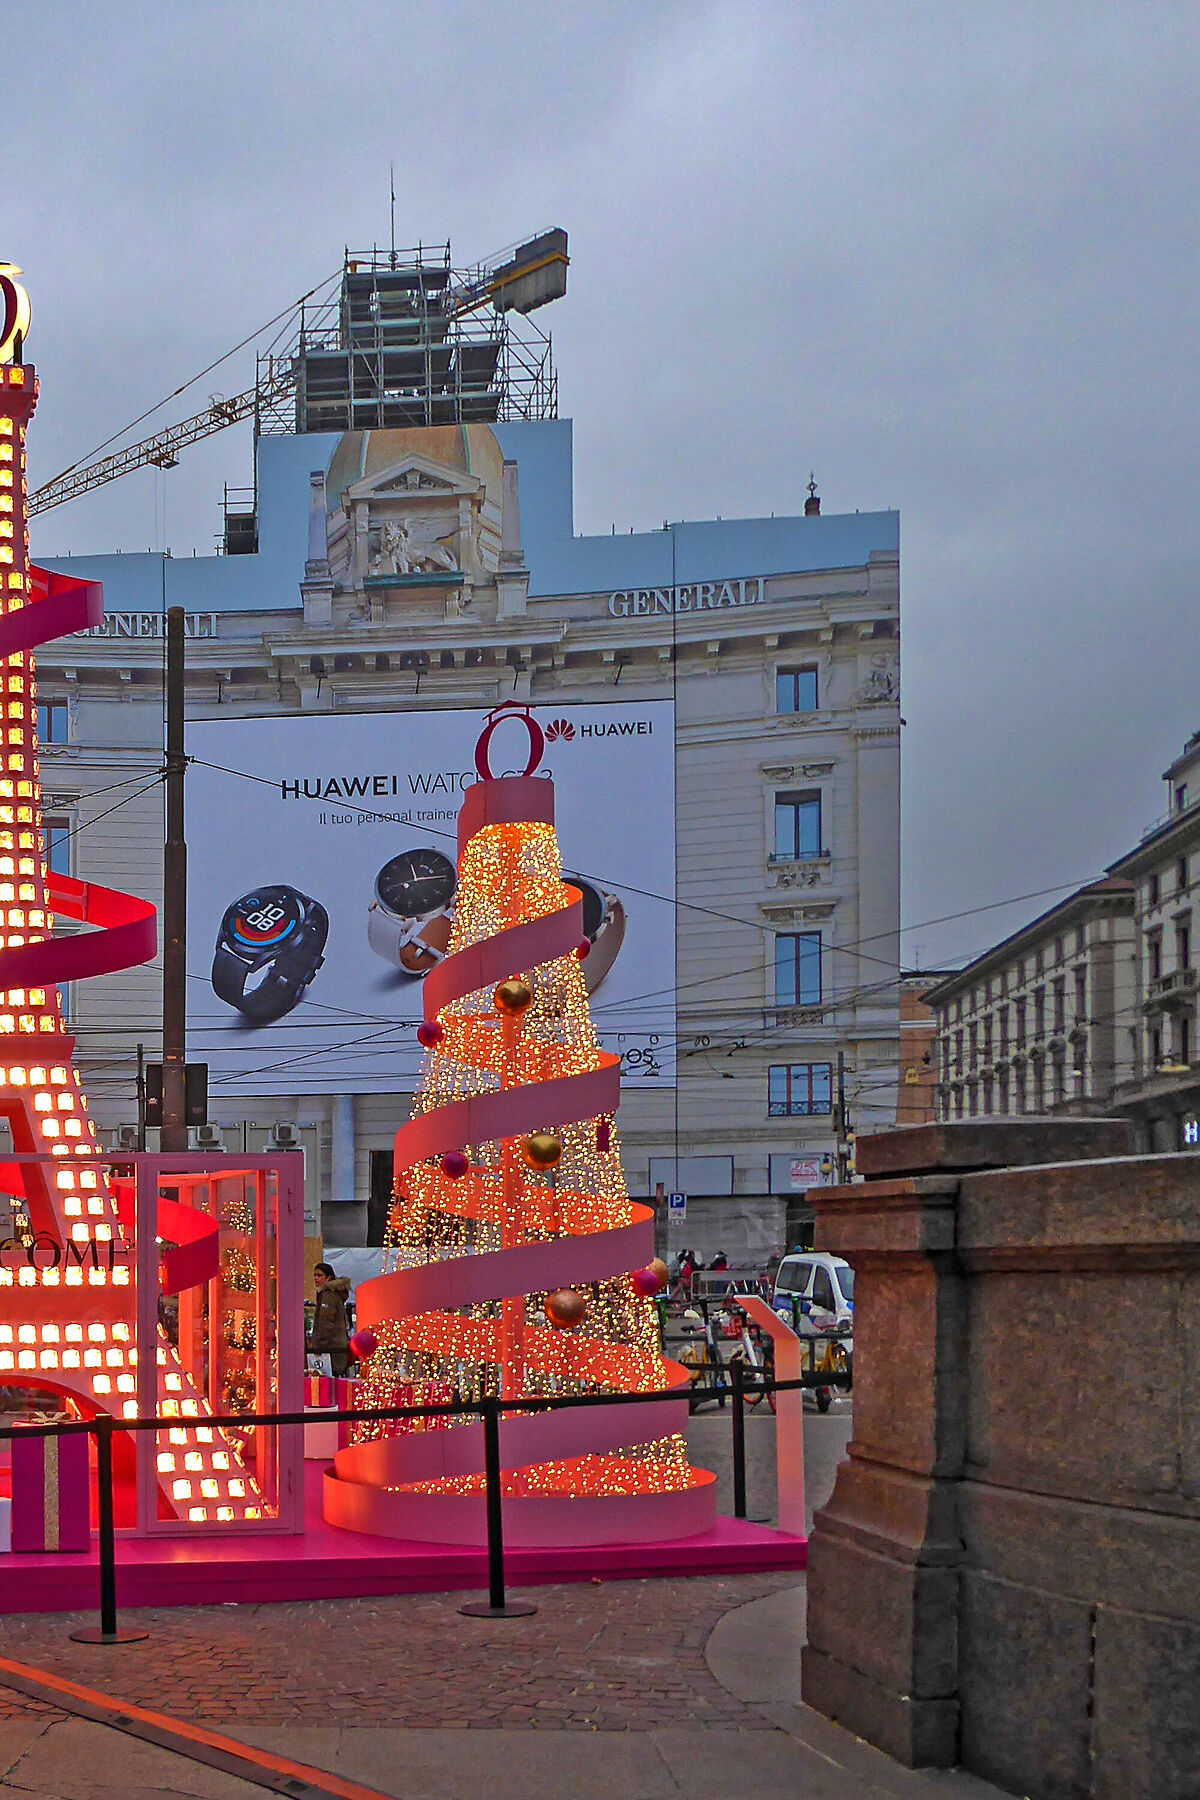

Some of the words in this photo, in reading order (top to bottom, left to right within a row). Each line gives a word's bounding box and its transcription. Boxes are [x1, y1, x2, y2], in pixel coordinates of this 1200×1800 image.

[608, 577, 767, 618] GENERALI
[581, 721, 653, 738] HUAWEI
[281, 775, 398, 800] HUAWEI
[332, 813, 353, 824] tuo
[357, 810, 412, 826] personal
[417, 808, 459, 821] trainer
[673, 1194, 683, 1207] P
